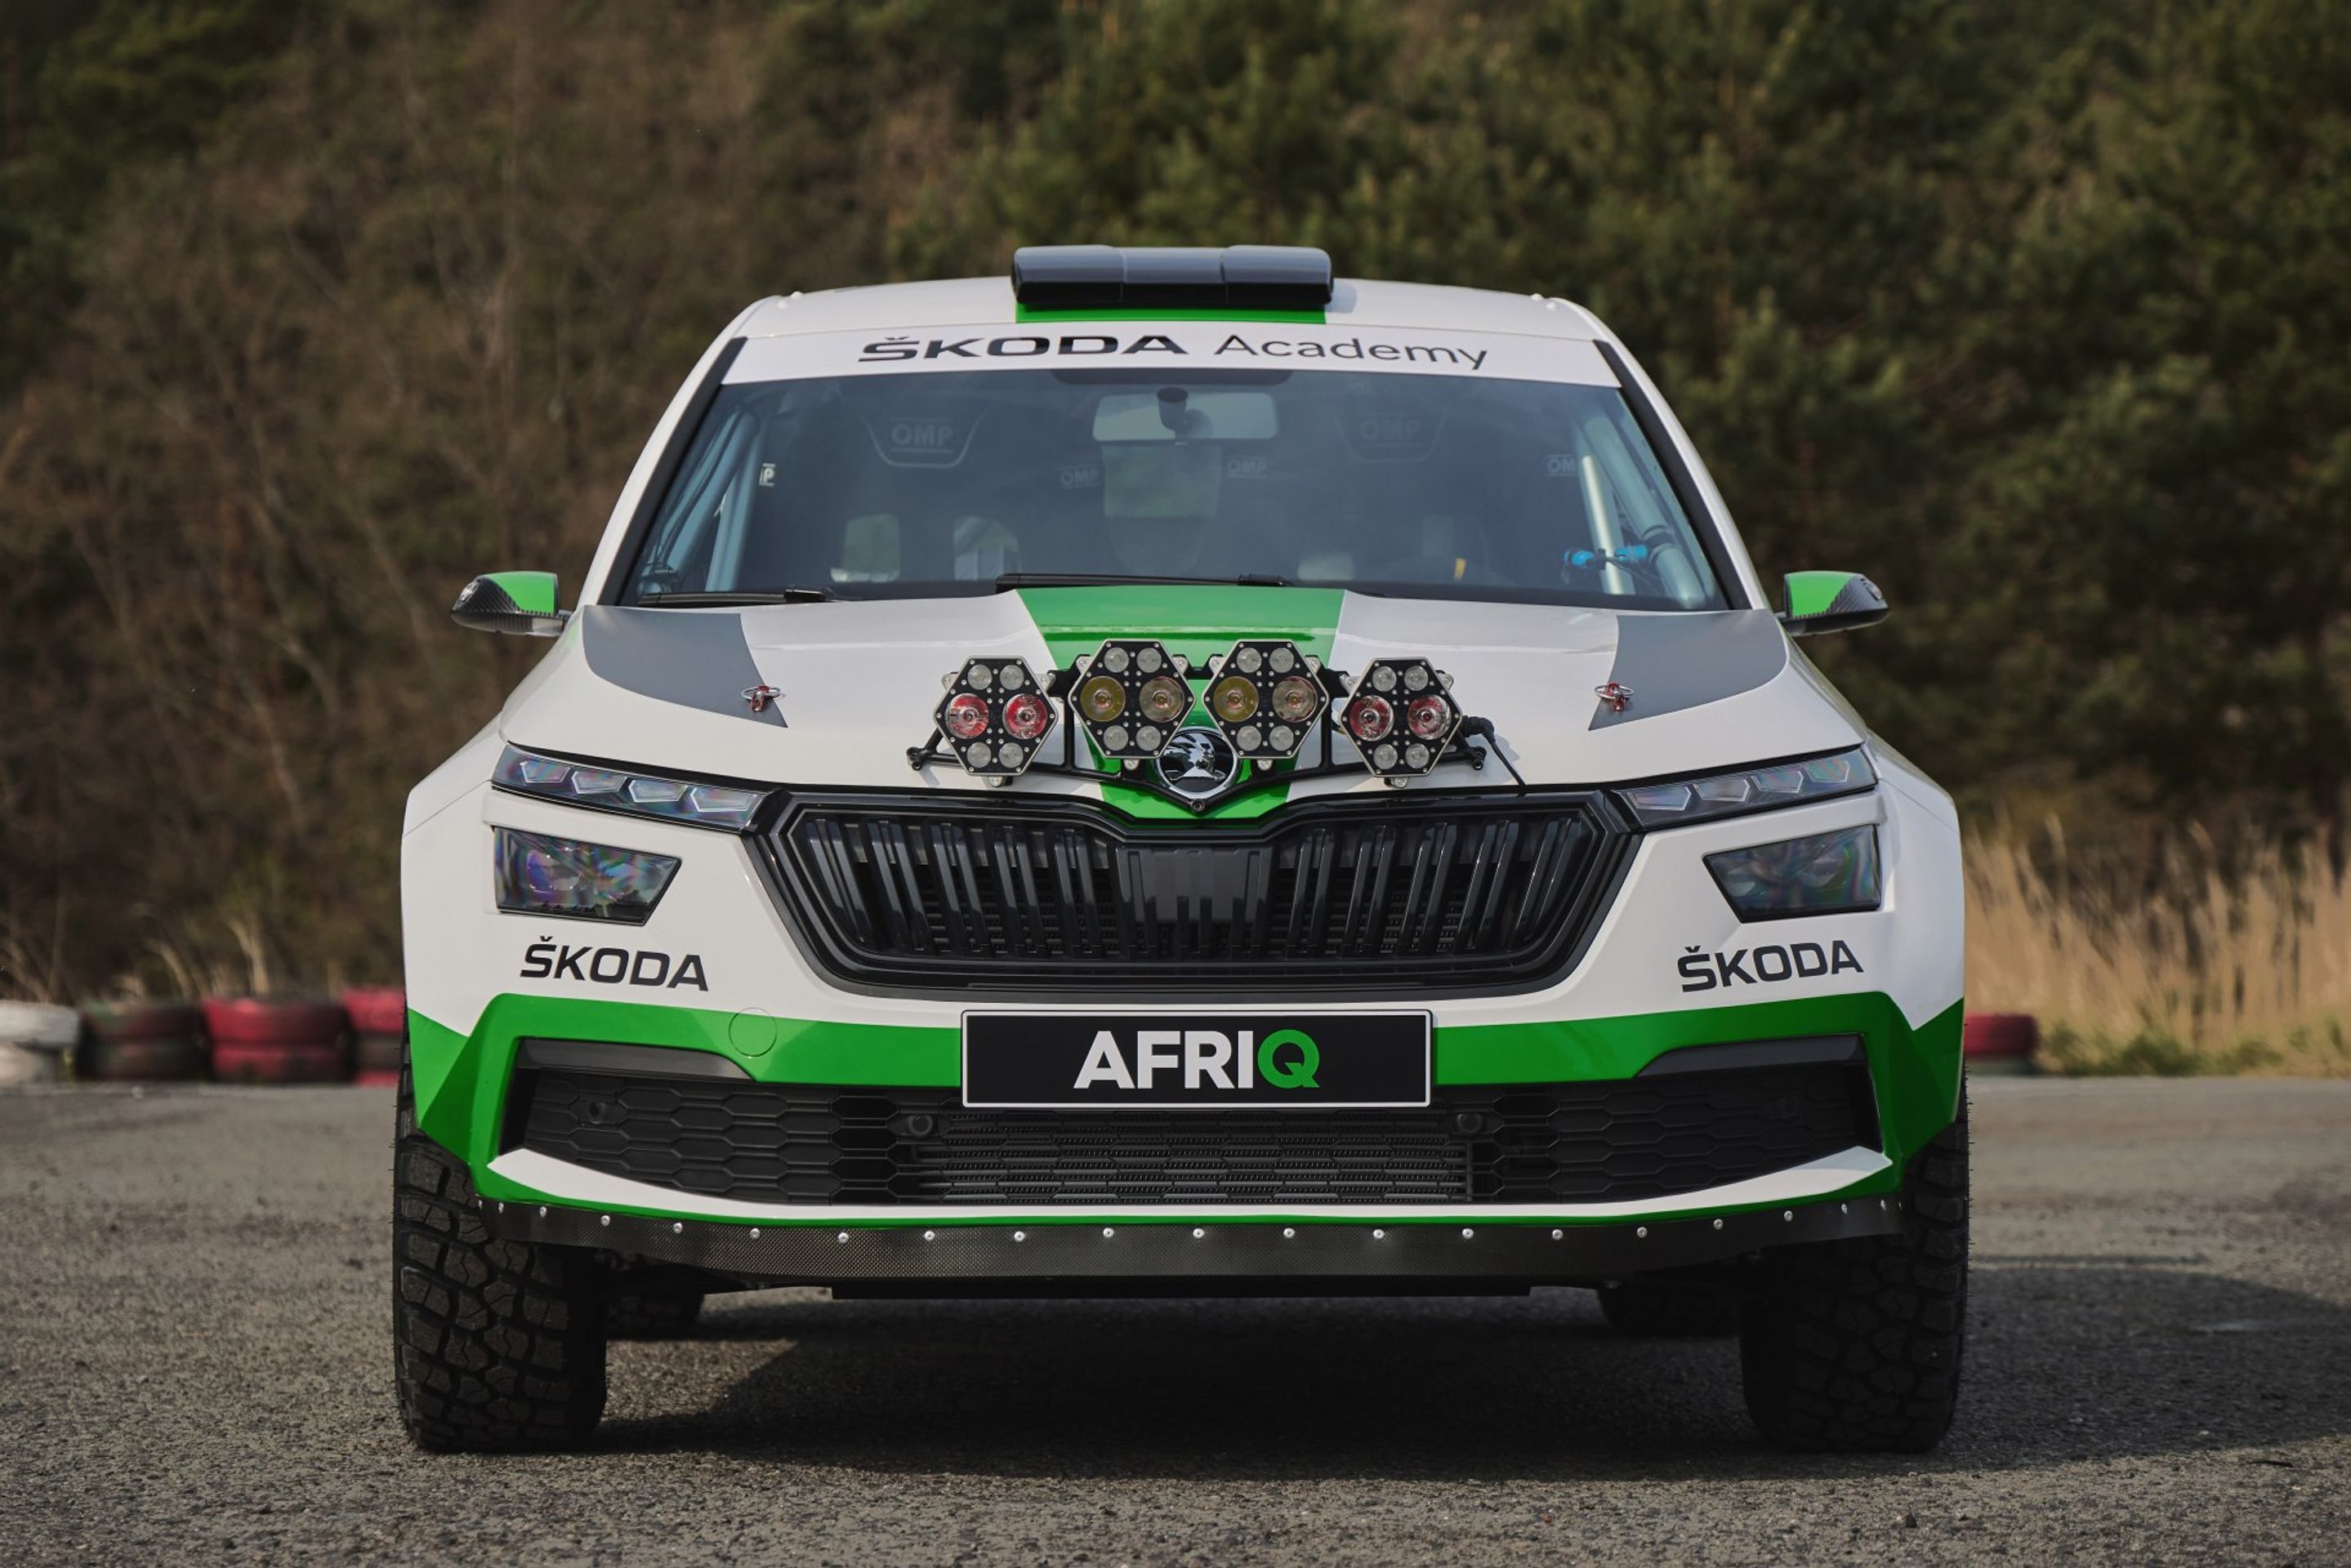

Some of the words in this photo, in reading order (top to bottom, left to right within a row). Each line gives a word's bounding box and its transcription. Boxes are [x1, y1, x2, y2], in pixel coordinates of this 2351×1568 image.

[858, 335, 1188, 363] ŠKODA
[1214, 334, 1488, 371] Academy
[890, 422, 953, 446] OMP
[1362, 418, 1420, 440] OMP
[1226, 459, 1268, 474] OMP
[1546, 458, 1576, 472] OM
[1060, 470, 1099, 486] OMP
[520, 936, 709, 991] ŠKODA
[1677, 940, 1864, 993] ŠKODA
[1073, 1029, 1320, 1089] AFRIQ
